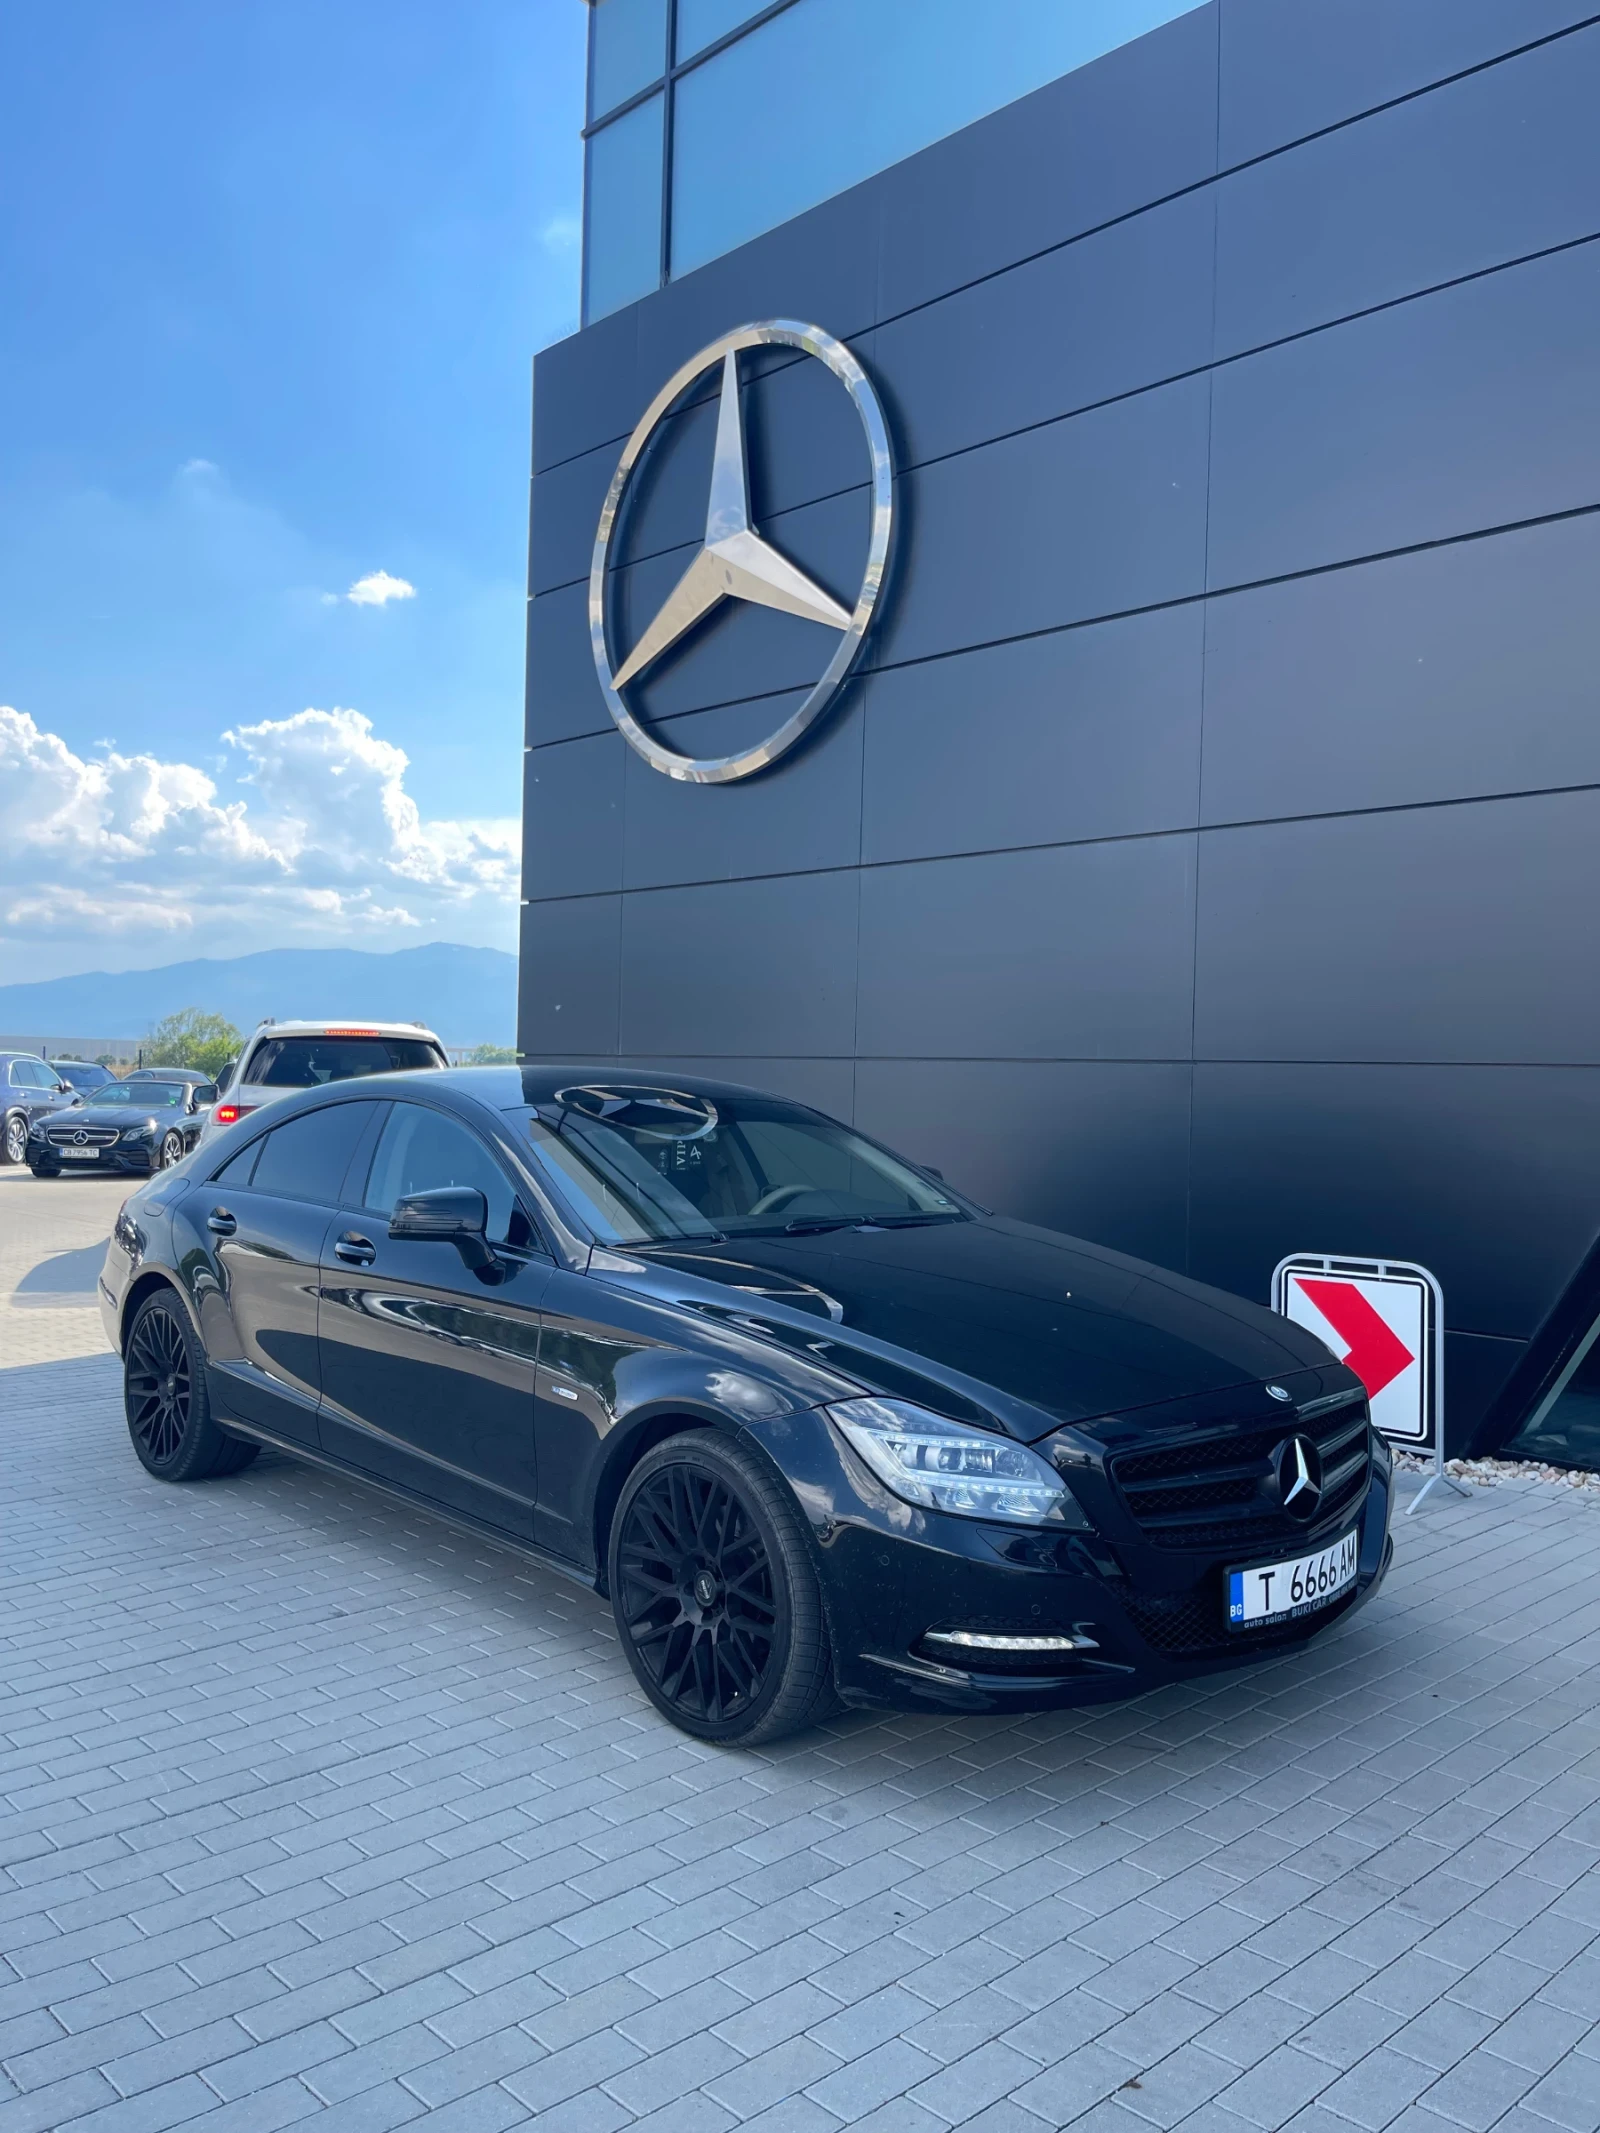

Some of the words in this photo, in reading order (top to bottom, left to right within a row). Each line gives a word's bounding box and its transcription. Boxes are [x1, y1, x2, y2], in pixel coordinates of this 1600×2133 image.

[1258, 1571, 1276, 1611] T
[1290, 1550, 1337, 1603] 6666
[1340, 1536, 1355, 1581] AM
[1229, 1603, 1243, 1618] BG
[1244, 1617, 1263, 1629] auto
[1265, 1612, 1287, 1625] salon
[1291, 1603, 1311, 1618] BUKI
[1312, 1597, 1327, 1610] CAR
